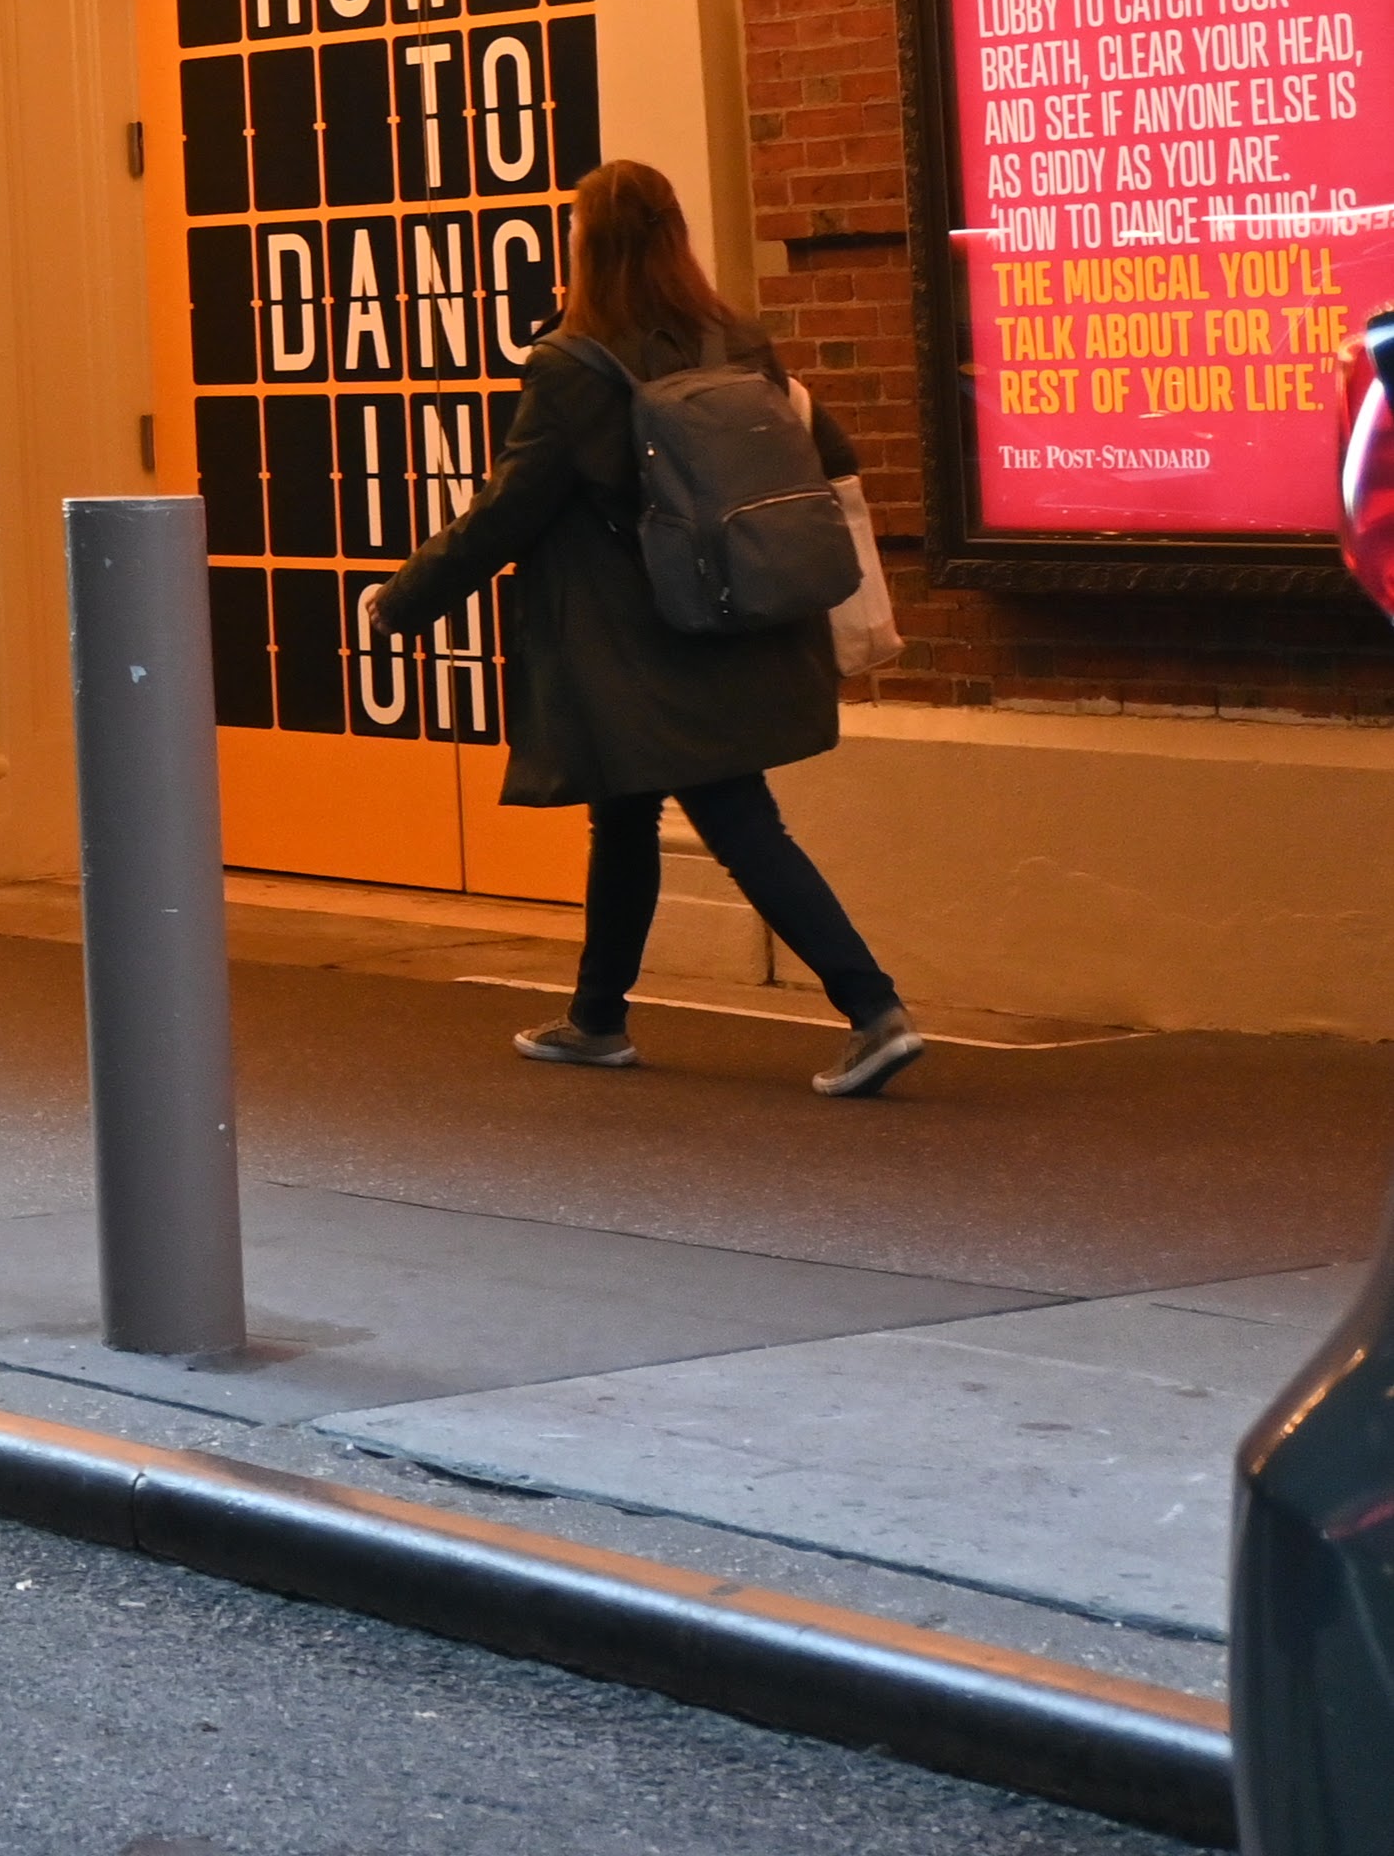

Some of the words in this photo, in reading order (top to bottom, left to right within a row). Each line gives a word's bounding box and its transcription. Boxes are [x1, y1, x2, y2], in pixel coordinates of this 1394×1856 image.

[981, 38, 1089, 92] BREATH,
[1097, 27, 1185, 83] CLEAR
[1192, 20, 1269, 73] YOUR
[1278, 13, 1363, 68] HEAD,
[404, 34, 535, 189] TO
[984, 97, 1036, 145] AND
[1045, 93, 1092, 141] SEE
[1101, 90, 1122, 137] IF
[1133, 80, 1241, 135] ANYONE
[1250, 74, 1321, 126] ELSE
[1329, 70, 1357, 120] IS
[988, 154, 1021, 200] AS
[1031, 147, 1106, 197] GIDDY
[1116, 143, 1152, 192] AS
[1160, 140, 1215, 188] YOU
[1227, 135, 1290, 185] ARE.
[989, 203, 1058, 253] 'HOW
[1064, 203, 1101, 249] TO
[1111, 197, 1197, 246] DANCE
[1208, 195, 1235, 244] IN
[268, 218, 542, 373] DANC
[992, 261, 1053, 307] THE
[1063, 254, 1209, 304] MUSICAL
[1218, 244, 1341, 299] YOU'LL
[995, 314, 1076, 361] TALK
[1085, 310, 1194, 359] ABOUT
[1205, 309, 1271, 356] FOR
[1281, 306, 1348, 354] THE
[999, 369, 1079, 414] REST
[1091, 367, 1131, 413] OF
[1141, 365, 1234, 413] YOUR
[1244, 358, 1333, 412] LIFE."
[363, 403, 472, 548] IN
[999, 446, 1041, 468] THE
[357, 581, 487, 732] OH
